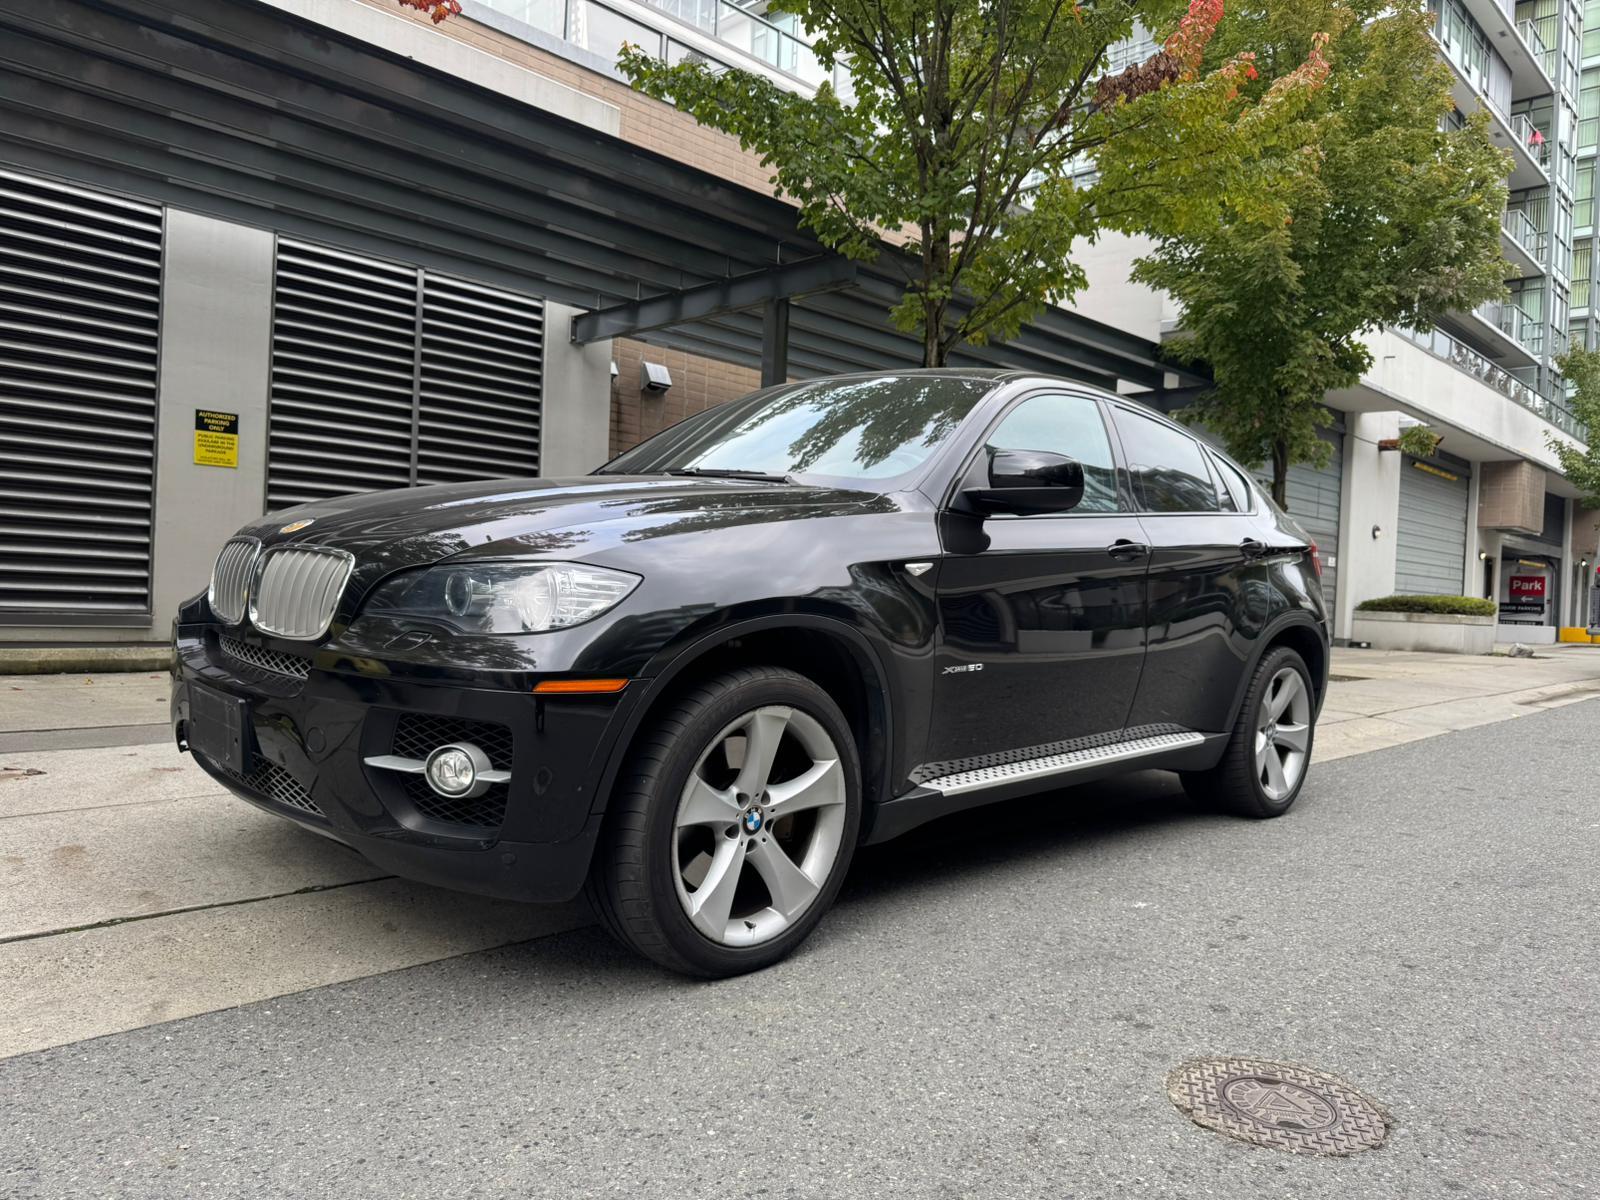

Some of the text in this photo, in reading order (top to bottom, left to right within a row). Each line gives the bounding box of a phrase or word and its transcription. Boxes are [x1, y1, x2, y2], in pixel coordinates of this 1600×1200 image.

[199, 411, 236, 421] AUTHORIZED
[203, 418, 230, 427] PARKING
[1512, 580, 1542, 590] Park
